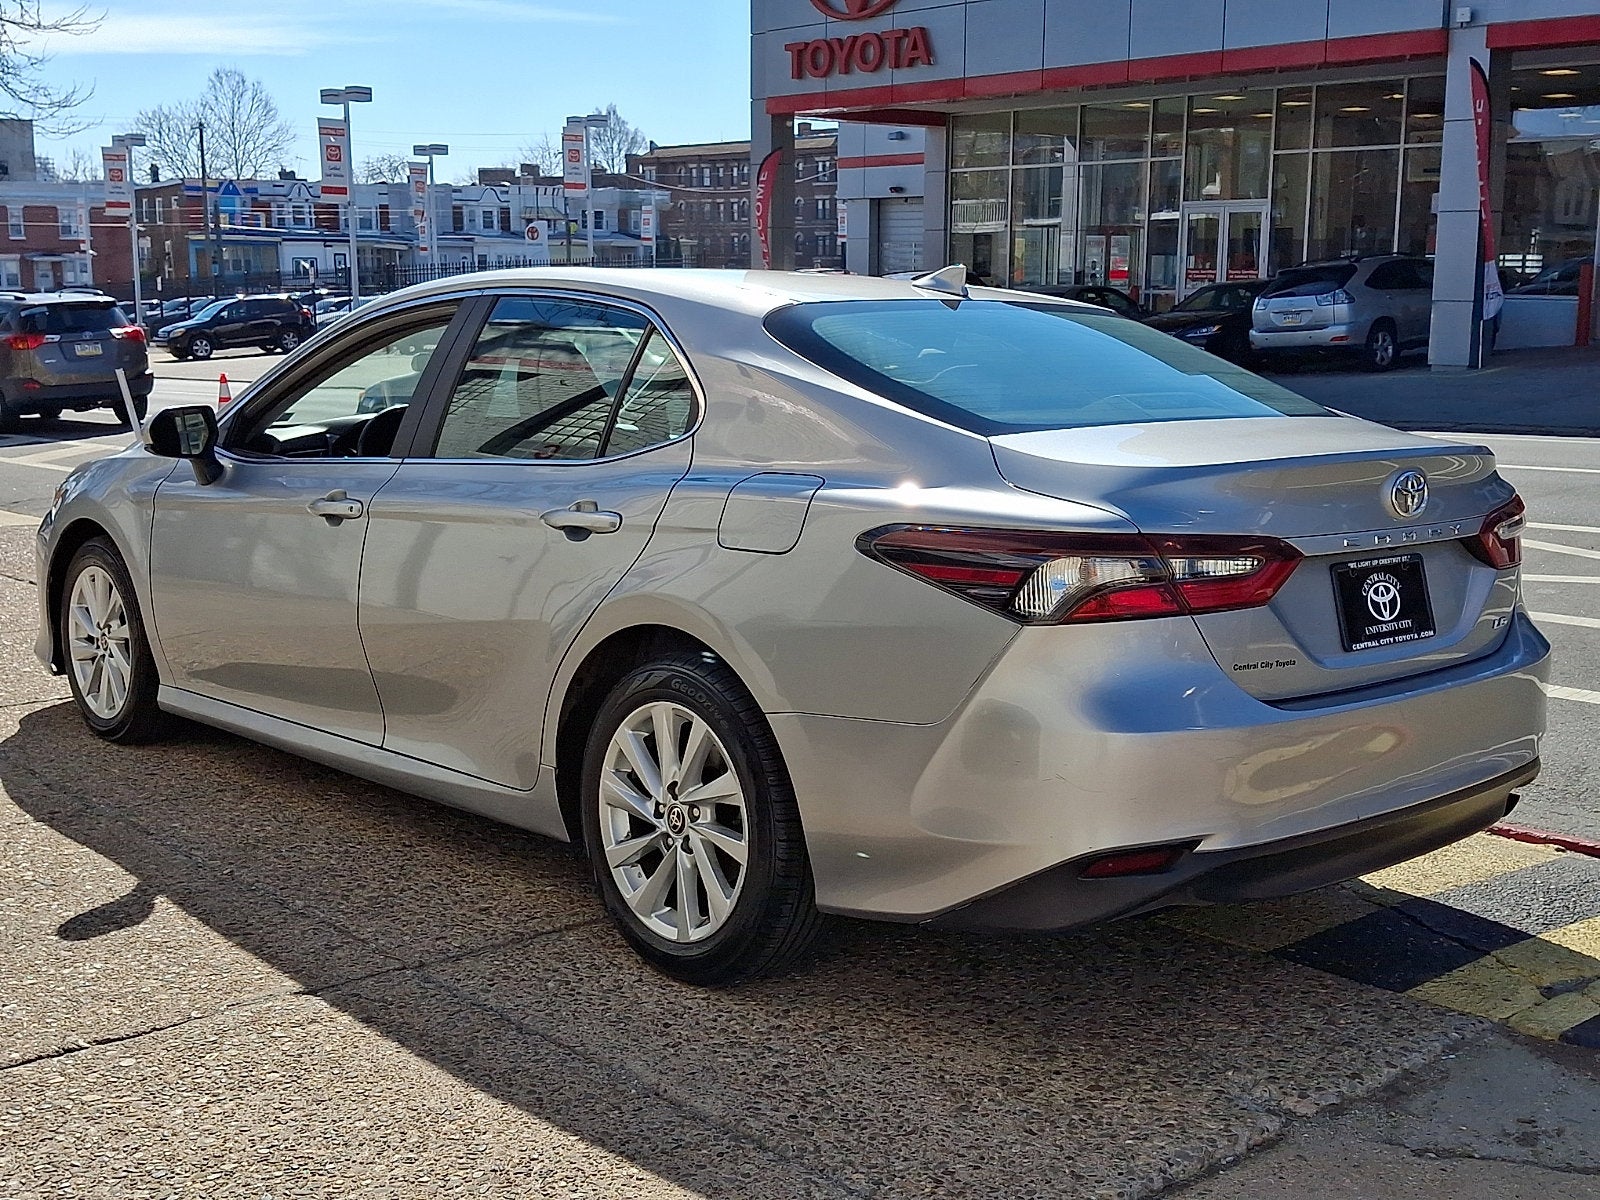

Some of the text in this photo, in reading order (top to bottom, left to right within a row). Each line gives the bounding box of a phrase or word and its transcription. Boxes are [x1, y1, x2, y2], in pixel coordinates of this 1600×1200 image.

[785, 27, 932, 79] TOYOTA
[1343, 524, 1461, 547] CAMRY
[1358, 560, 1371, 568] LIGHT
[1379, 556, 1401, 565] CHESTNUT
[1361, 572, 1402, 596] CENTRAL CITY
[1365, 619, 1412, 635] UNIVERSITY CITY
[1352, 640, 1379, 650] CENTRAL
[1379, 637, 1394, 645] CITY
[1395, 633, 1418, 642] TOYOTA
[1233, 659, 1297, 671] Central City Toyota
